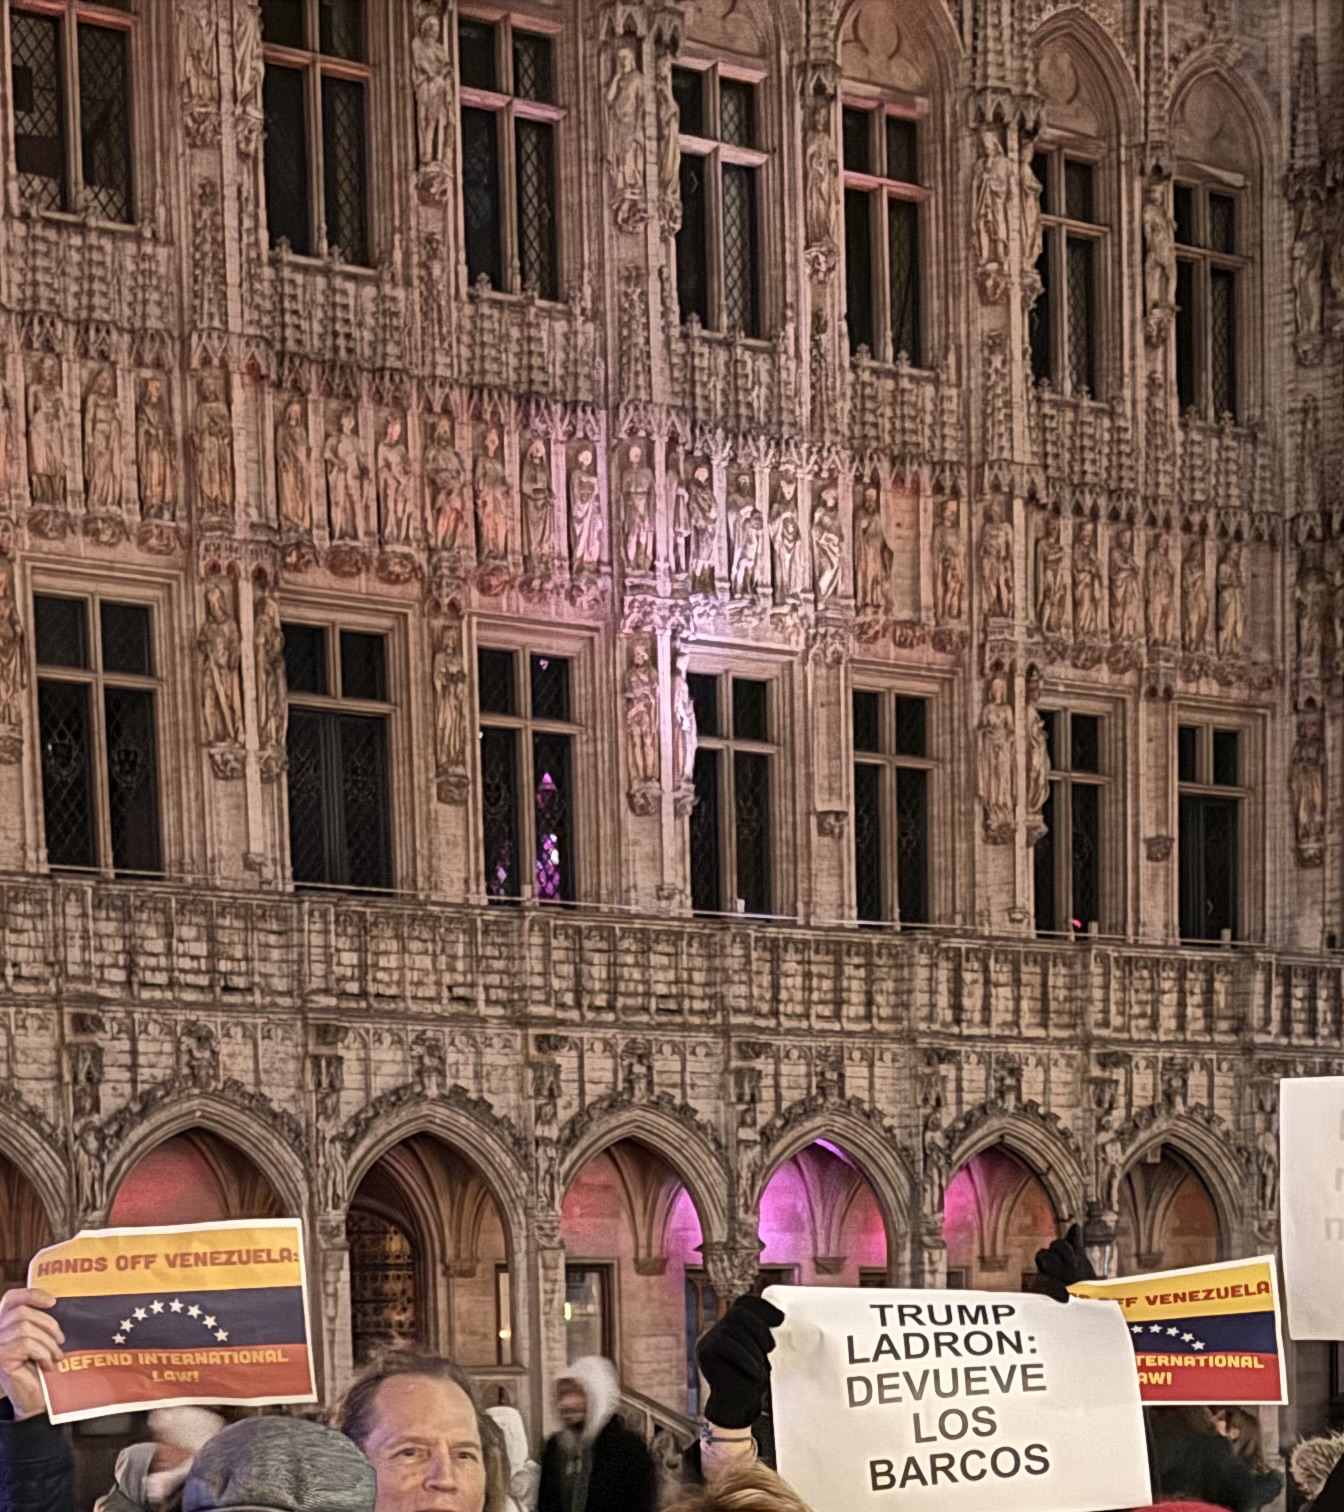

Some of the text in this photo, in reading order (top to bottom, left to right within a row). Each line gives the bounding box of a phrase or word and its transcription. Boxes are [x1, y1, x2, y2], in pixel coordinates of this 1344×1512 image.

[37, 1256, 108, 1277] HANDS
[115, 1253, 159, 1272] OFF
[1145, 1280, 1270, 1306] VENEZUELA
[869, 1304, 1017, 1328] TRUMP
[846, 1330, 1038, 1365] LADRON:
[57, 1349, 288, 1373] DEFEND INTERNATIONAL
[1136, 1355, 1265, 1369] TERNATIONAL
[151, 1370, 200, 1383] LAW!
[846, 1363, 1048, 1408] DEVUEVE
[1138, 1372, 1173, 1385] AW!
[912, 1405, 998, 1444] LOS
[869, 1443, 1051, 1492] BARCOS
